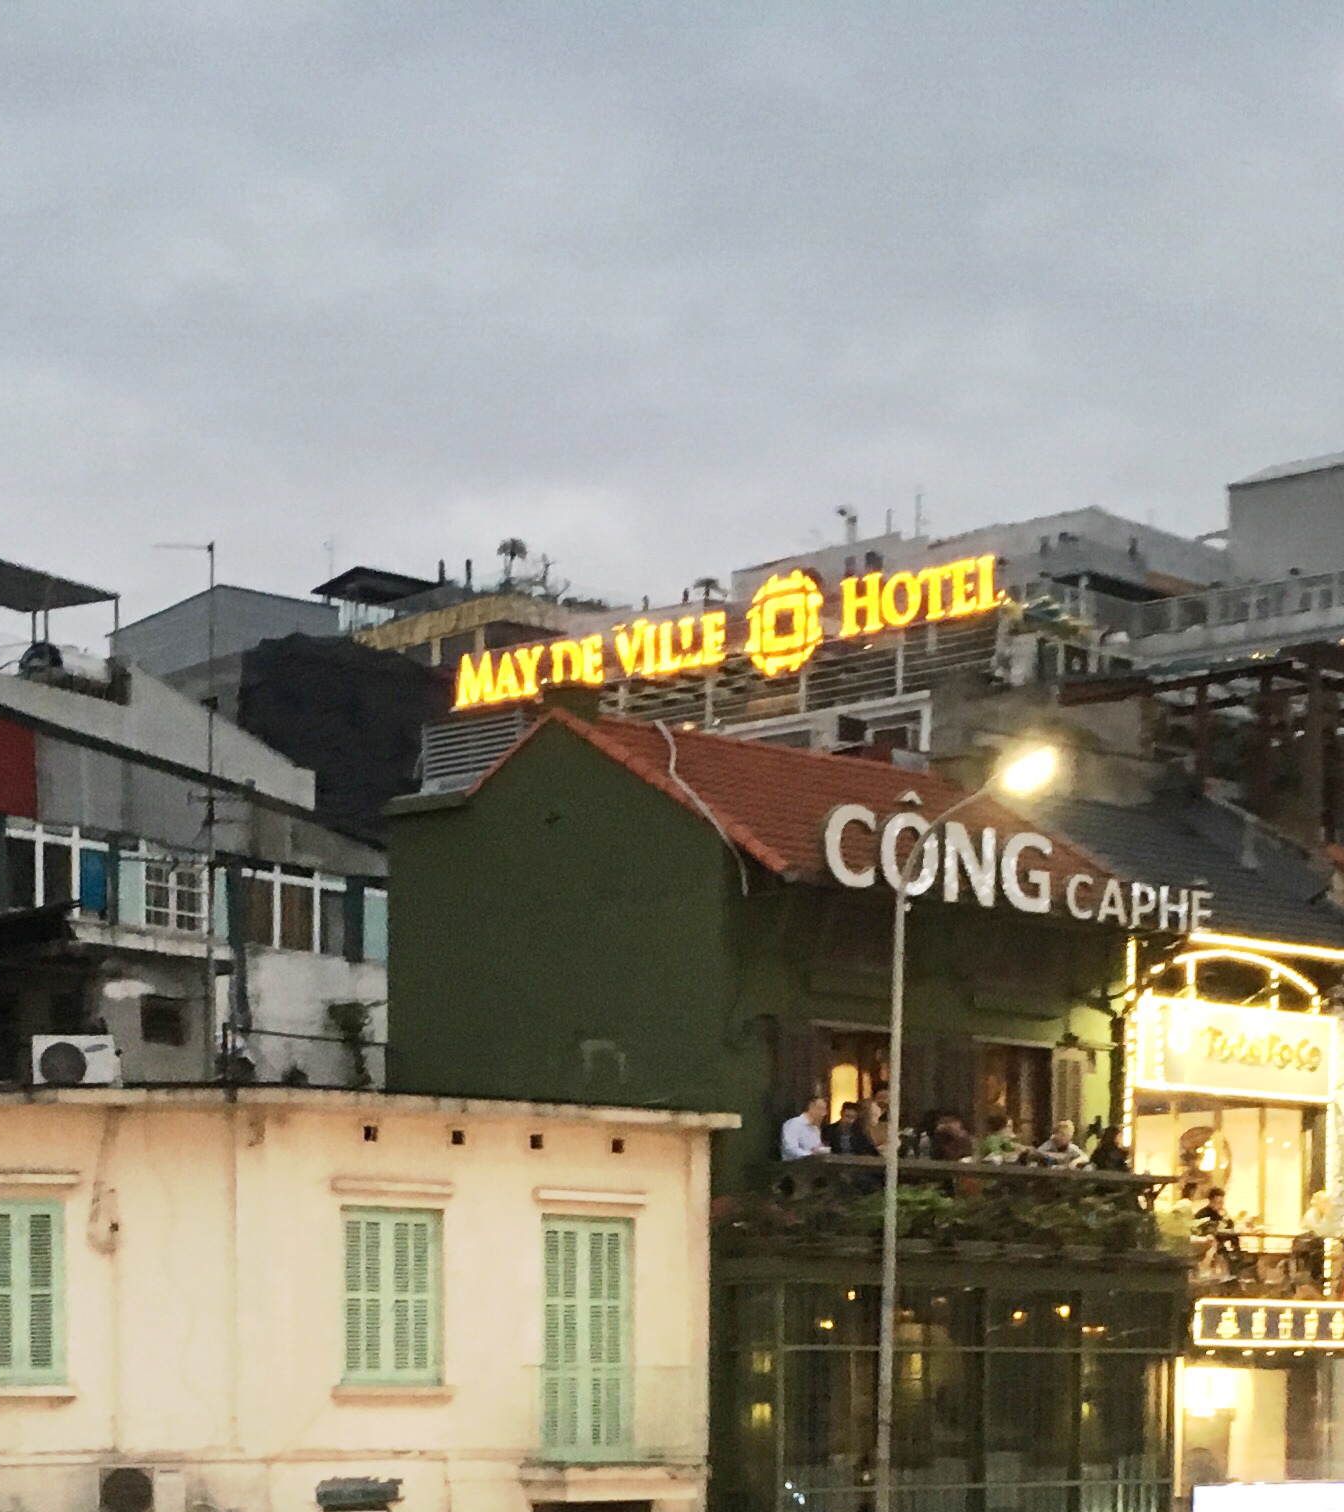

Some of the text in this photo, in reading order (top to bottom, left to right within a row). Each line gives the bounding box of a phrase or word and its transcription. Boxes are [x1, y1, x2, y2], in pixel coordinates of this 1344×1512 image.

[456, 553, 1003, 707] MAY DE VILLE HOTEL
